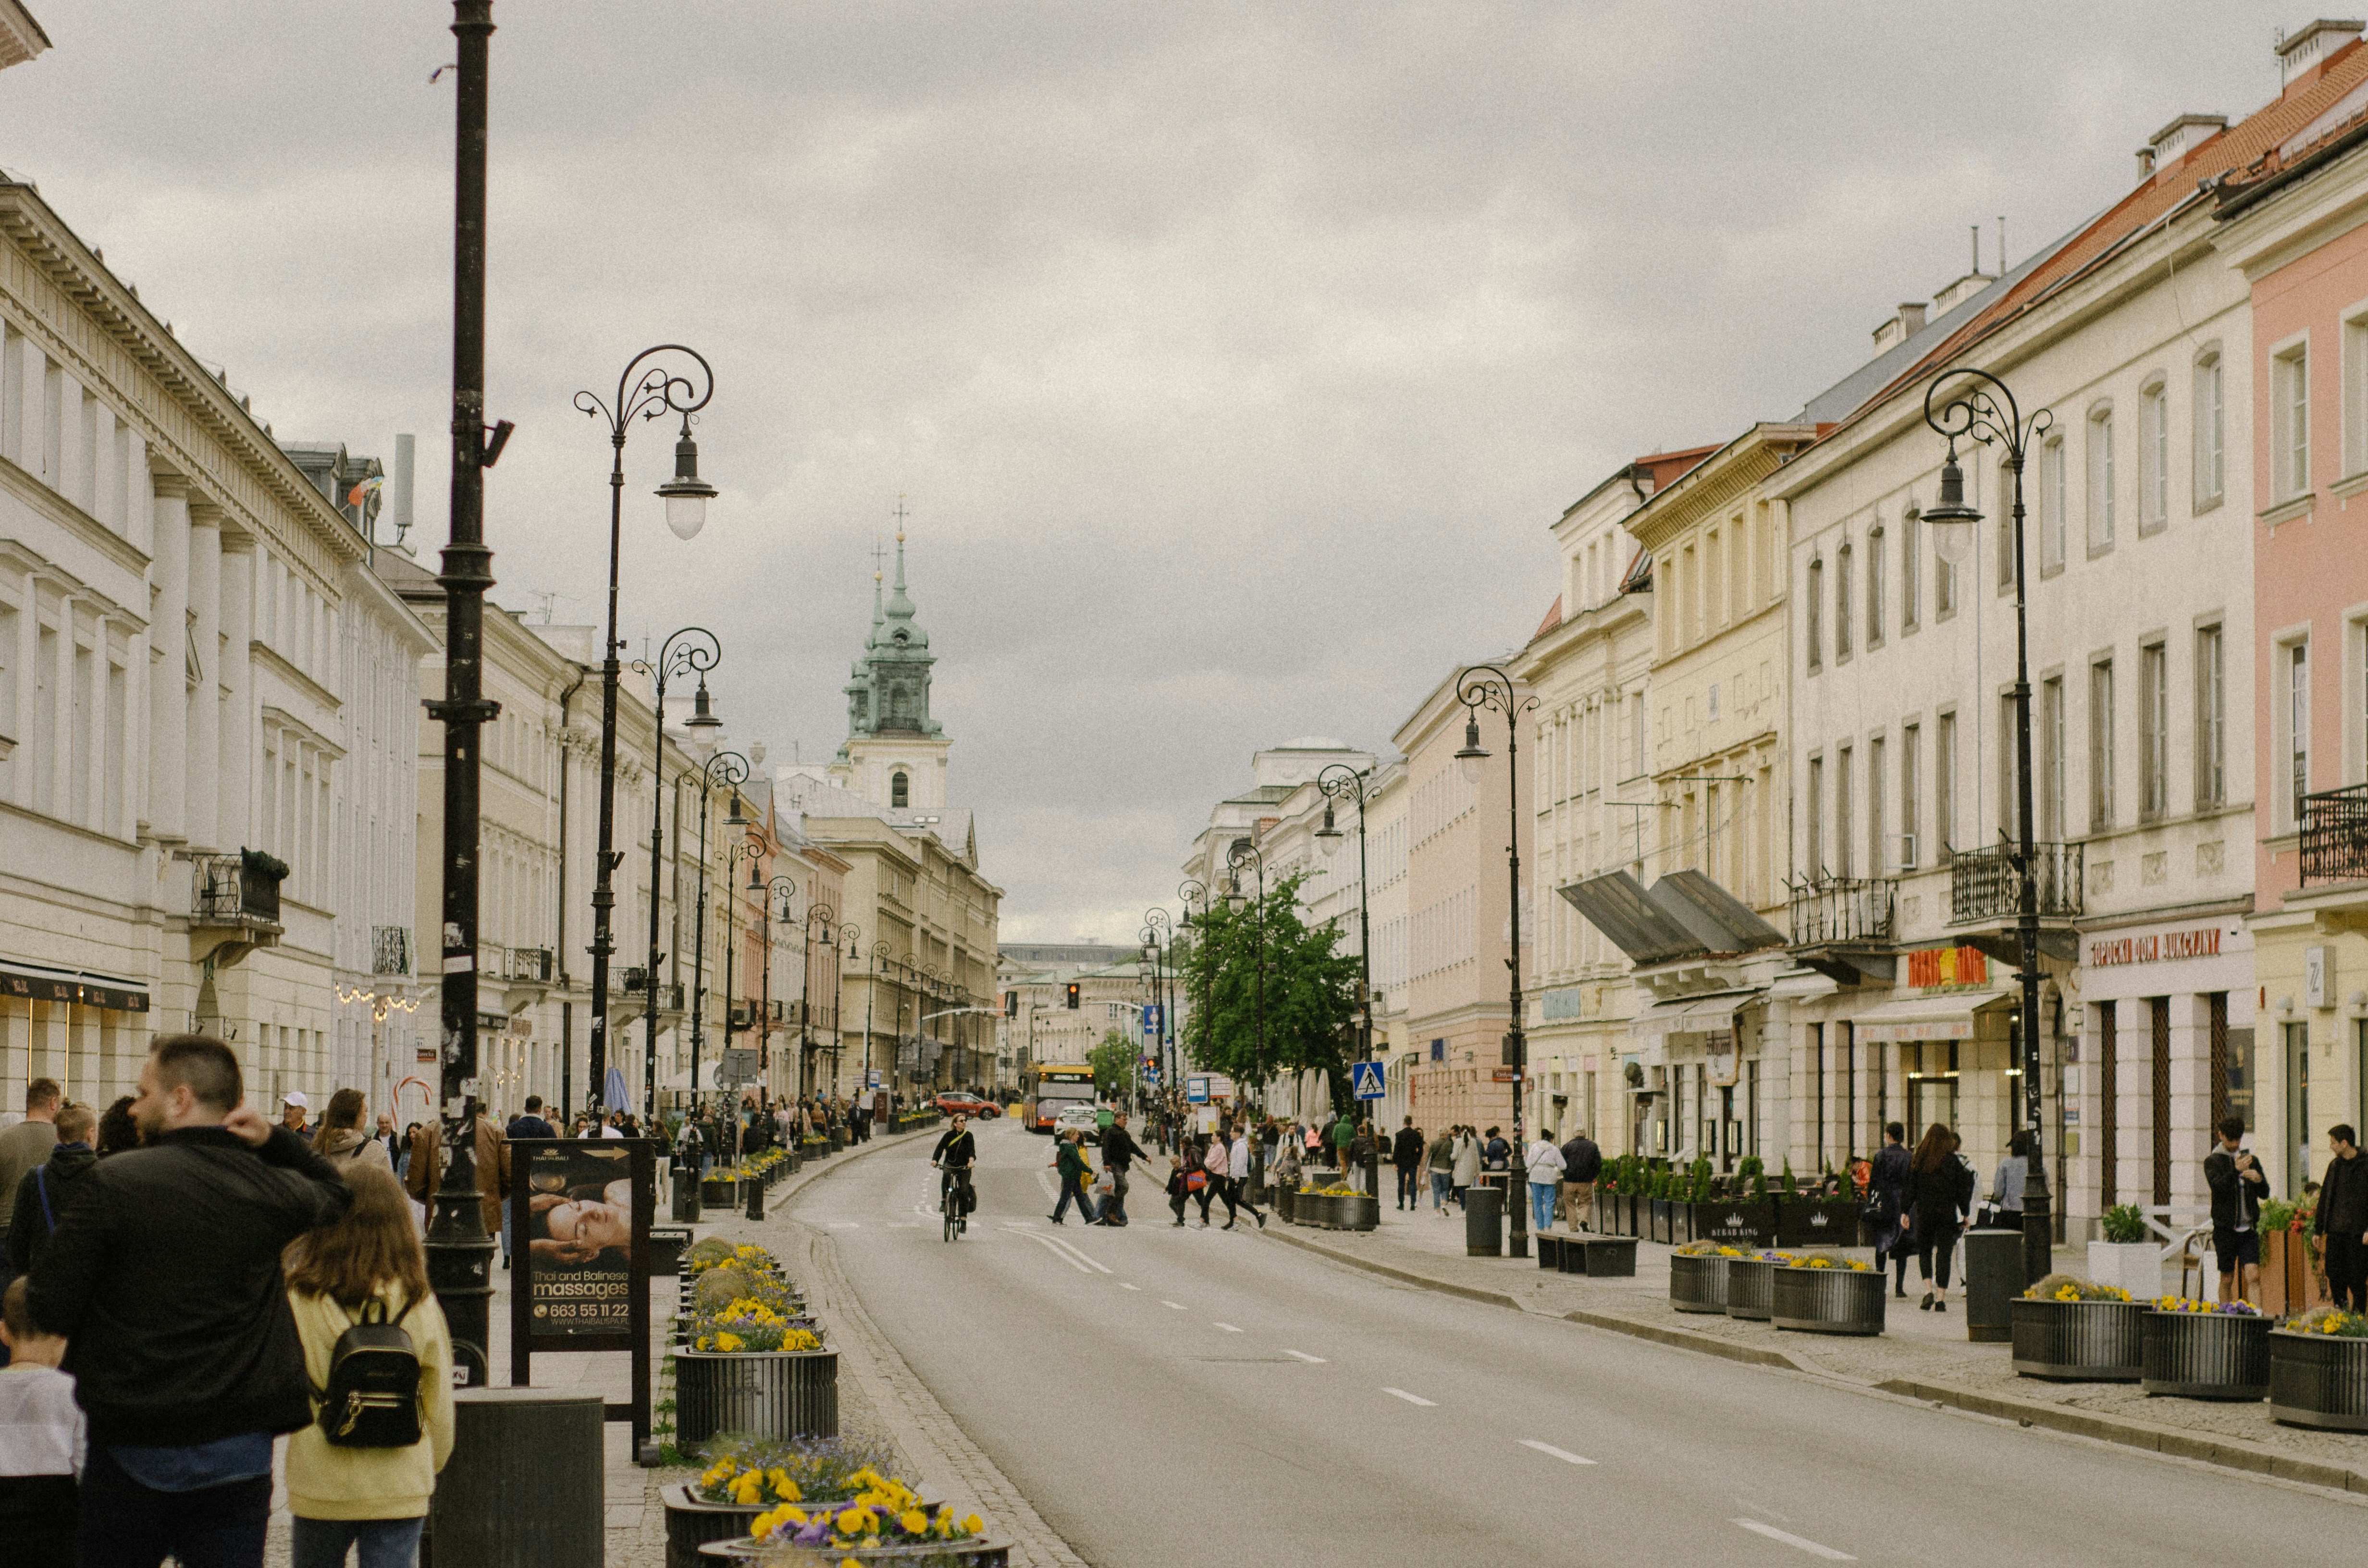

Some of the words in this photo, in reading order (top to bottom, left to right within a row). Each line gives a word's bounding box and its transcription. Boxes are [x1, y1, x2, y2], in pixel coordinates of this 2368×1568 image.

[2089, 938, 2132, 967] SOPOCKI
[2135, 935, 2158, 962] DOM
[2163, 928, 2220, 958] AUKCYJNY
[534, 1271, 556, 1281] Thai
[559, 1271, 581, 1281] and
[583, 1271, 629, 1281] Balinese
[533, 1283, 629, 1300] massages
[550, 1304, 576, 1317] 663
[580, 1304, 597, 1317] 55
[601, 1304, 609, 1316] 11
[612, 1304, 629, 1316] 22
